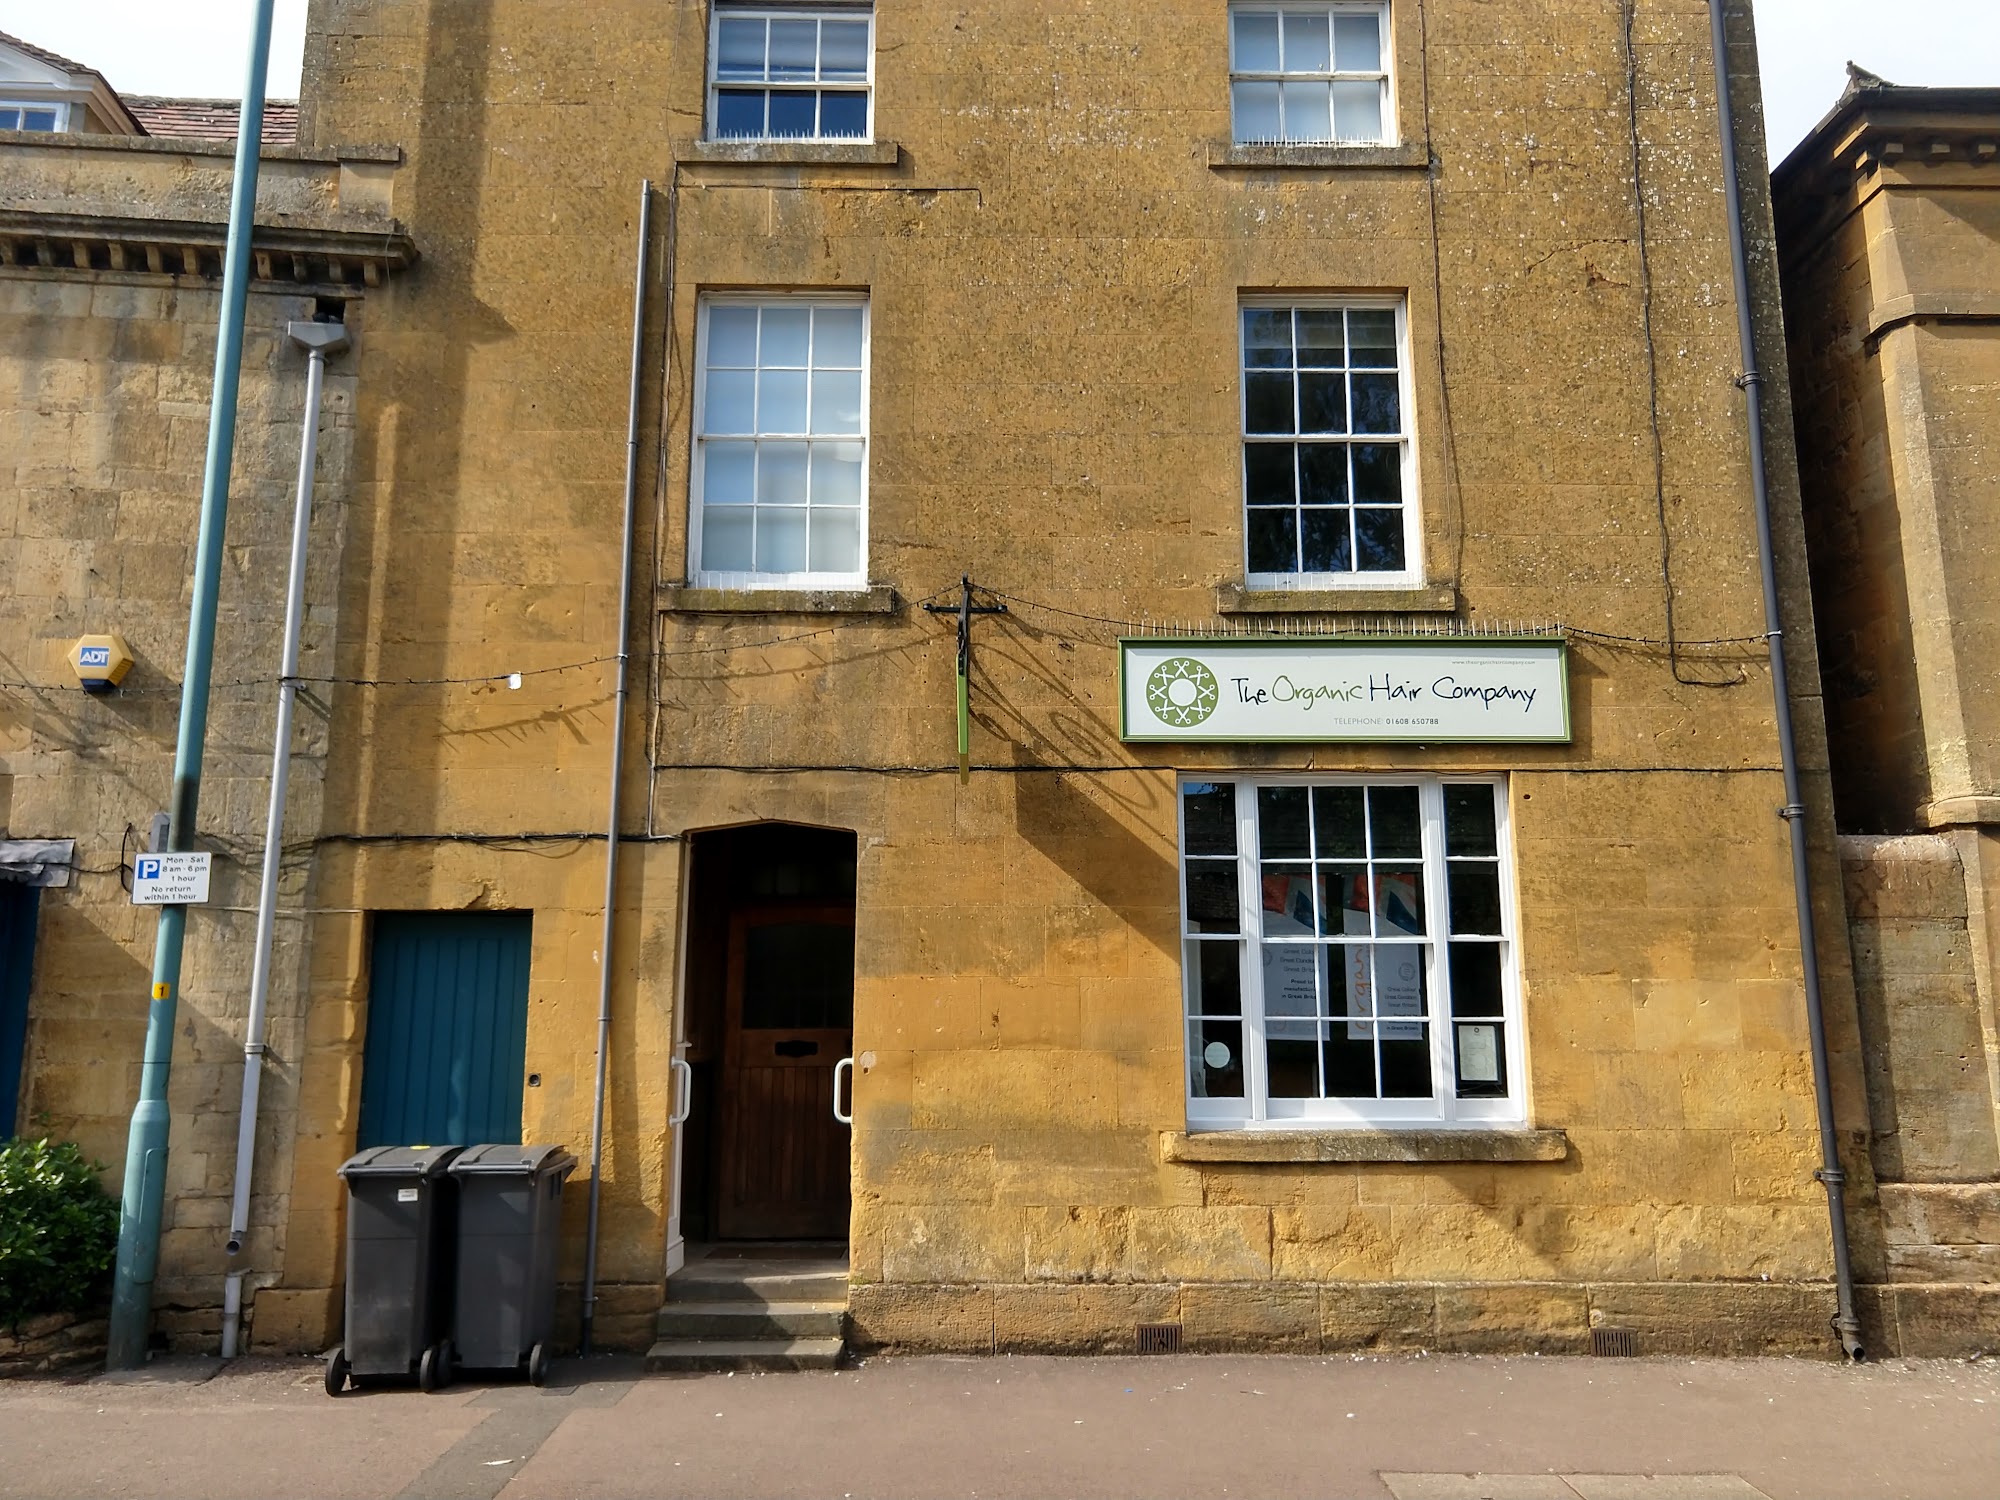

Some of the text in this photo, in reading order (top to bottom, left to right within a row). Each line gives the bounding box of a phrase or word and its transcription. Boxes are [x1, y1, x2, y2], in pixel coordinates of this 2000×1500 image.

[80, 651, 109, 663] ADT
[1230, 673, 1537, 713] The Organic Hair Company
[142, 860, 158, 879] P
